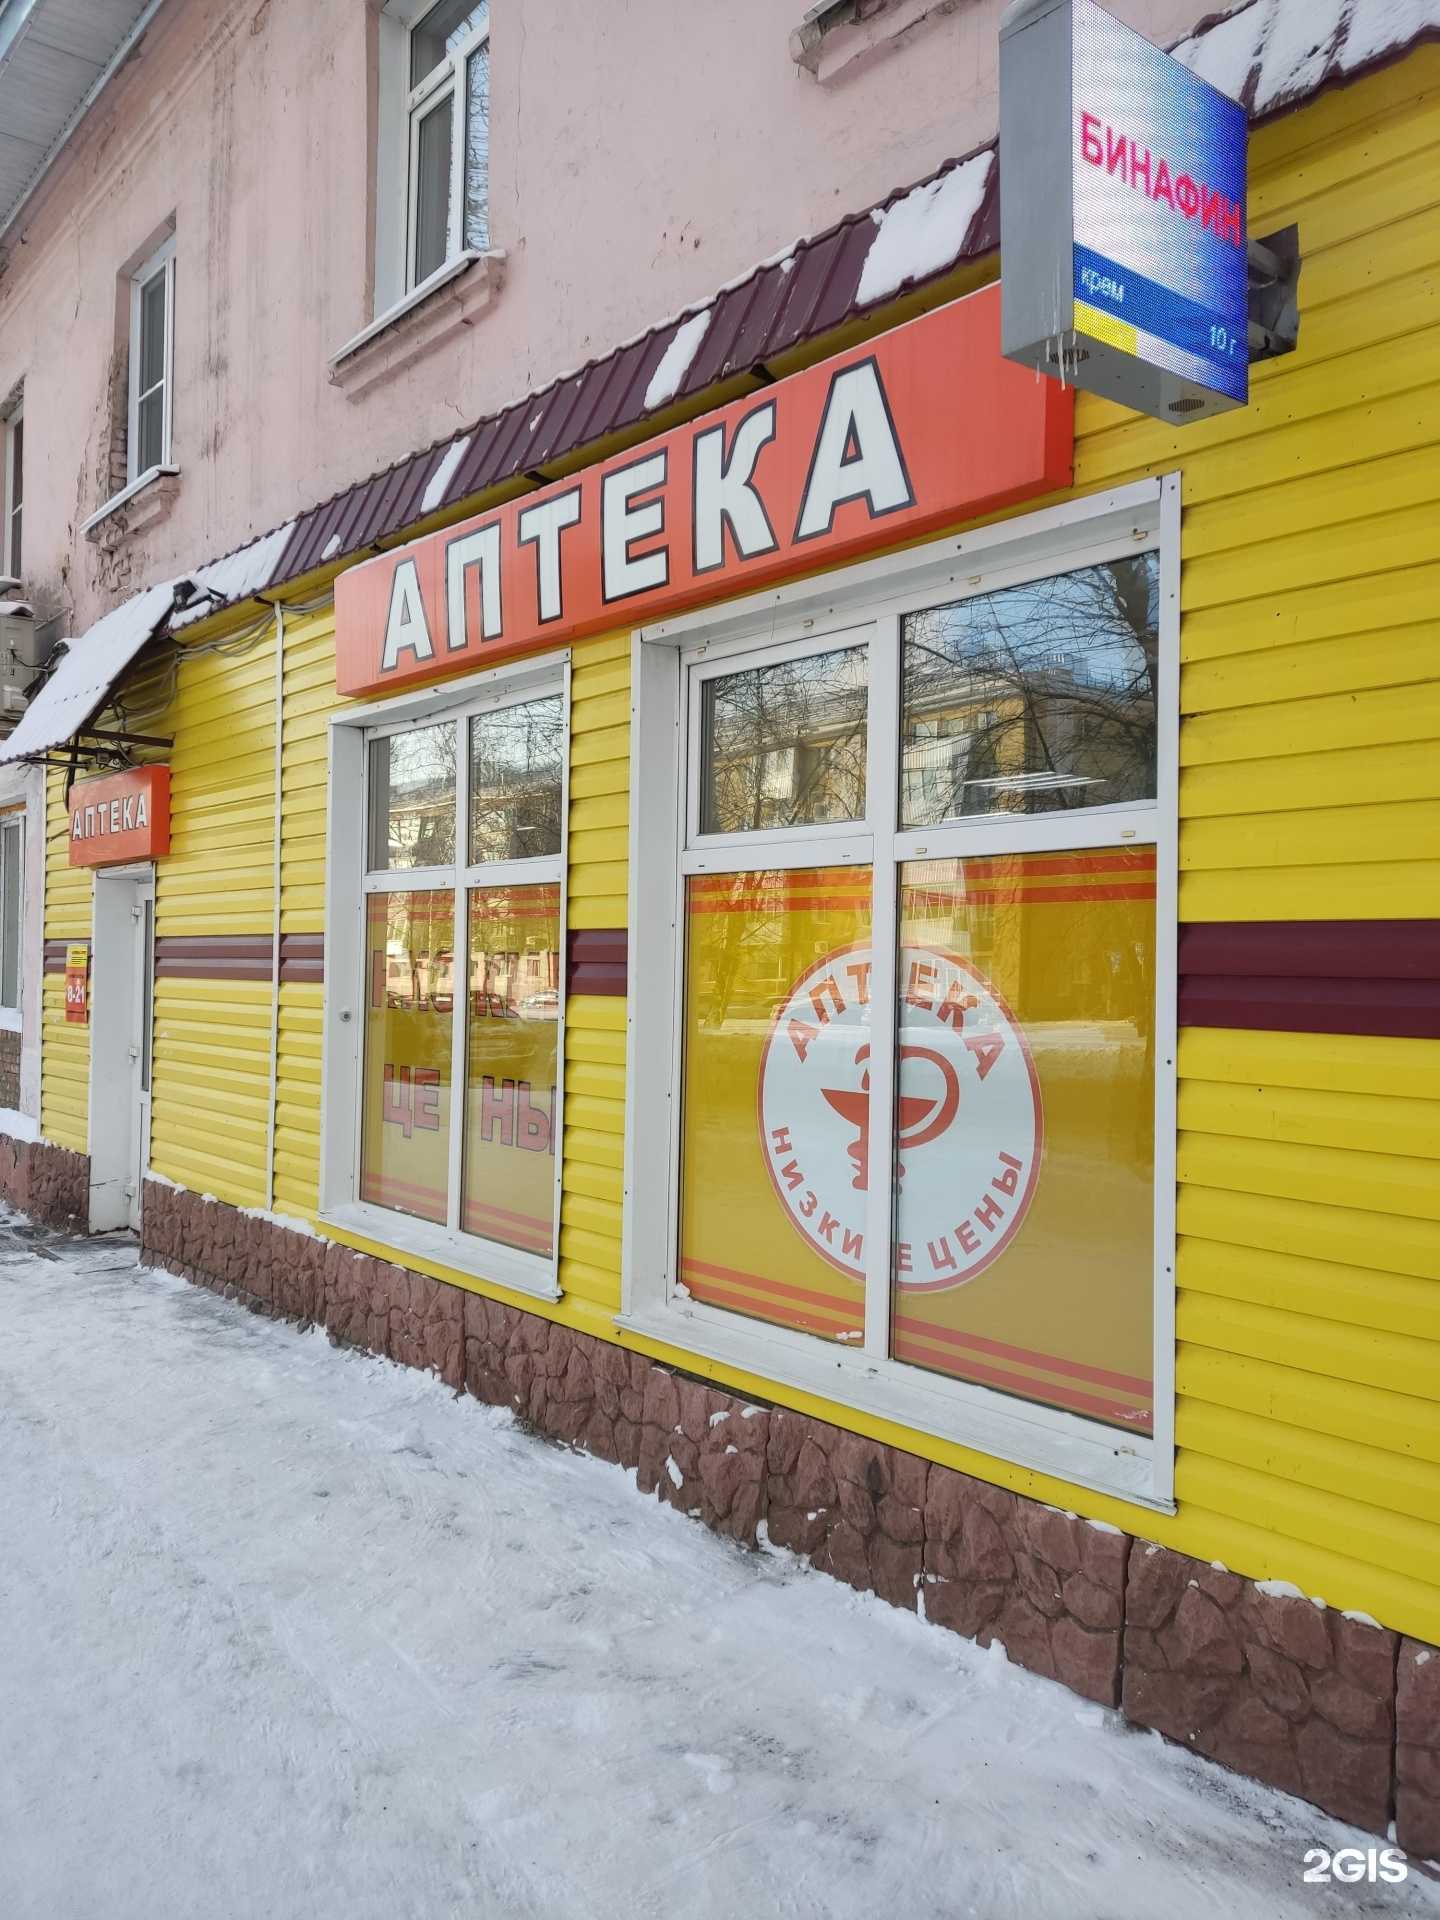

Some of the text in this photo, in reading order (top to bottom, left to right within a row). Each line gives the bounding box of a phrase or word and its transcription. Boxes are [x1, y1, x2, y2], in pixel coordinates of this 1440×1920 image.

[1080, 110, 1241, 247] БИНАФИН
[1081, 265, 1124, 302] крем
[379, 354, 916, 674] АПТЕКА
[71, 793, 148, 841] АПТЕКА
[786, 960, 1005, 1081] АПТЕКА
[771, 1126, 1024, 1272] НИЗКИЕ ЦЕНЫ
